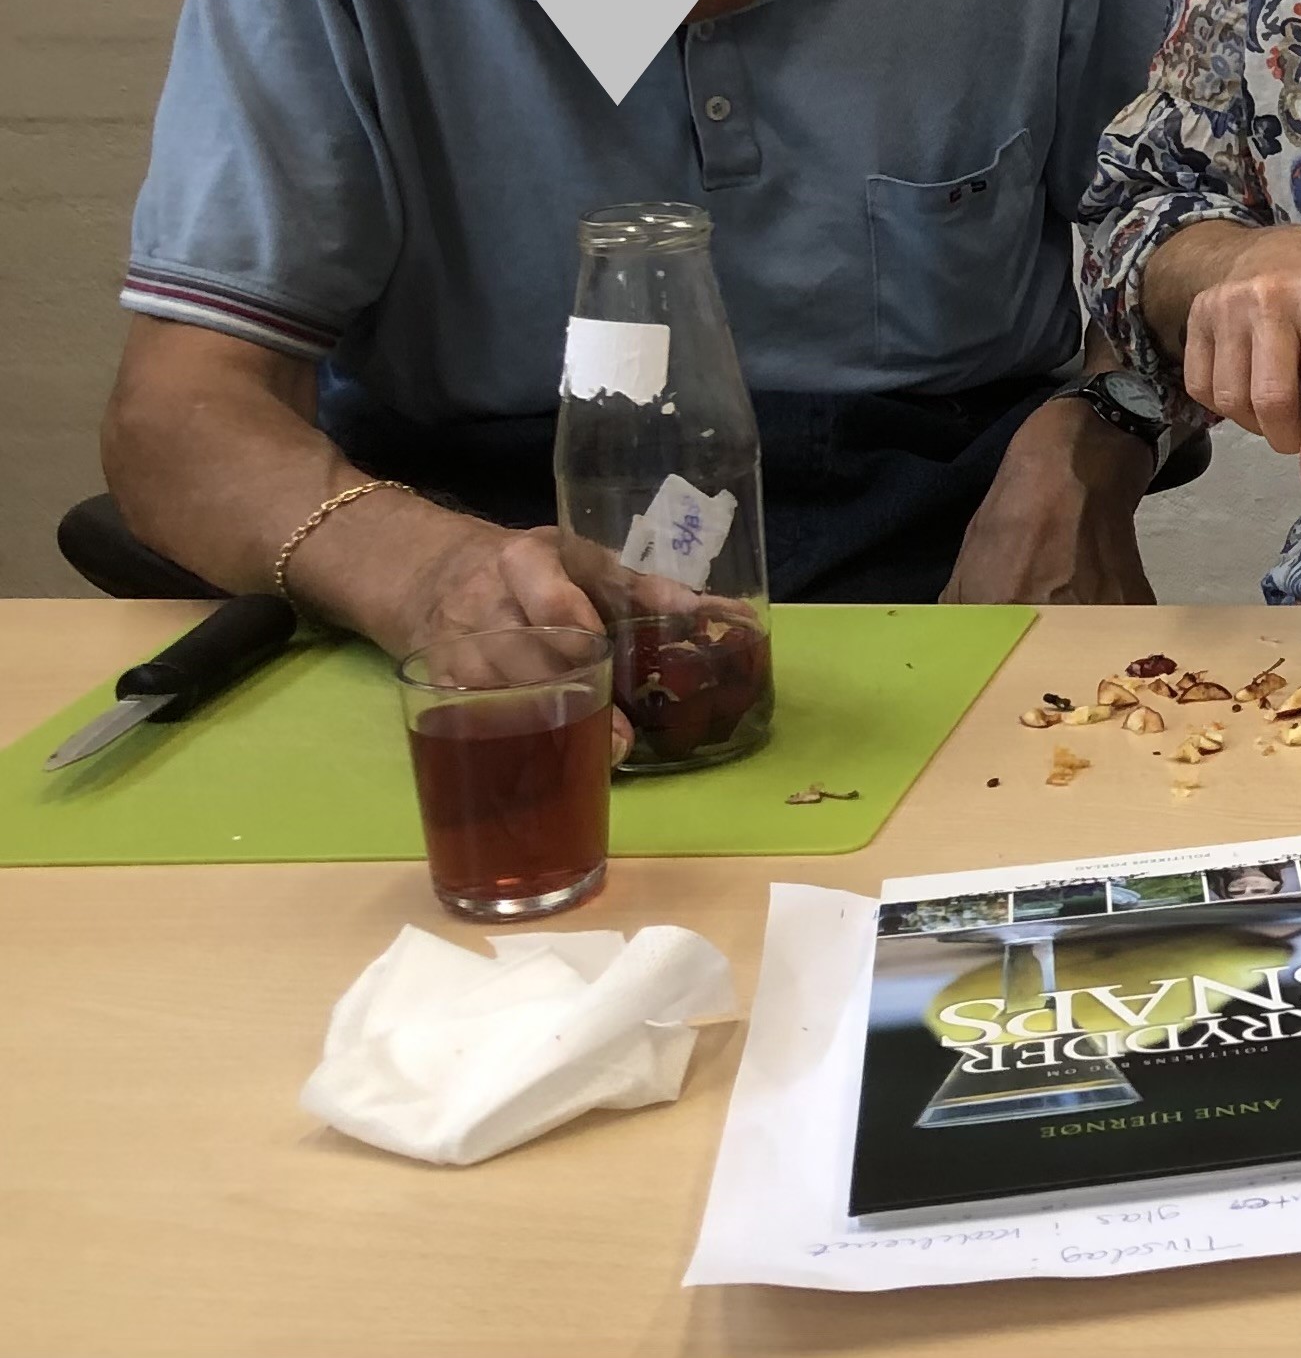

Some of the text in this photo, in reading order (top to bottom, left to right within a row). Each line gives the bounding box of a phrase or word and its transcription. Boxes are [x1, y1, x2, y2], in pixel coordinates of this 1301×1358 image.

[1143, 1044, 1270, 1068] POLITIKENS
[1039, 1097, 1283, 1139] ANNE HJERNØE
